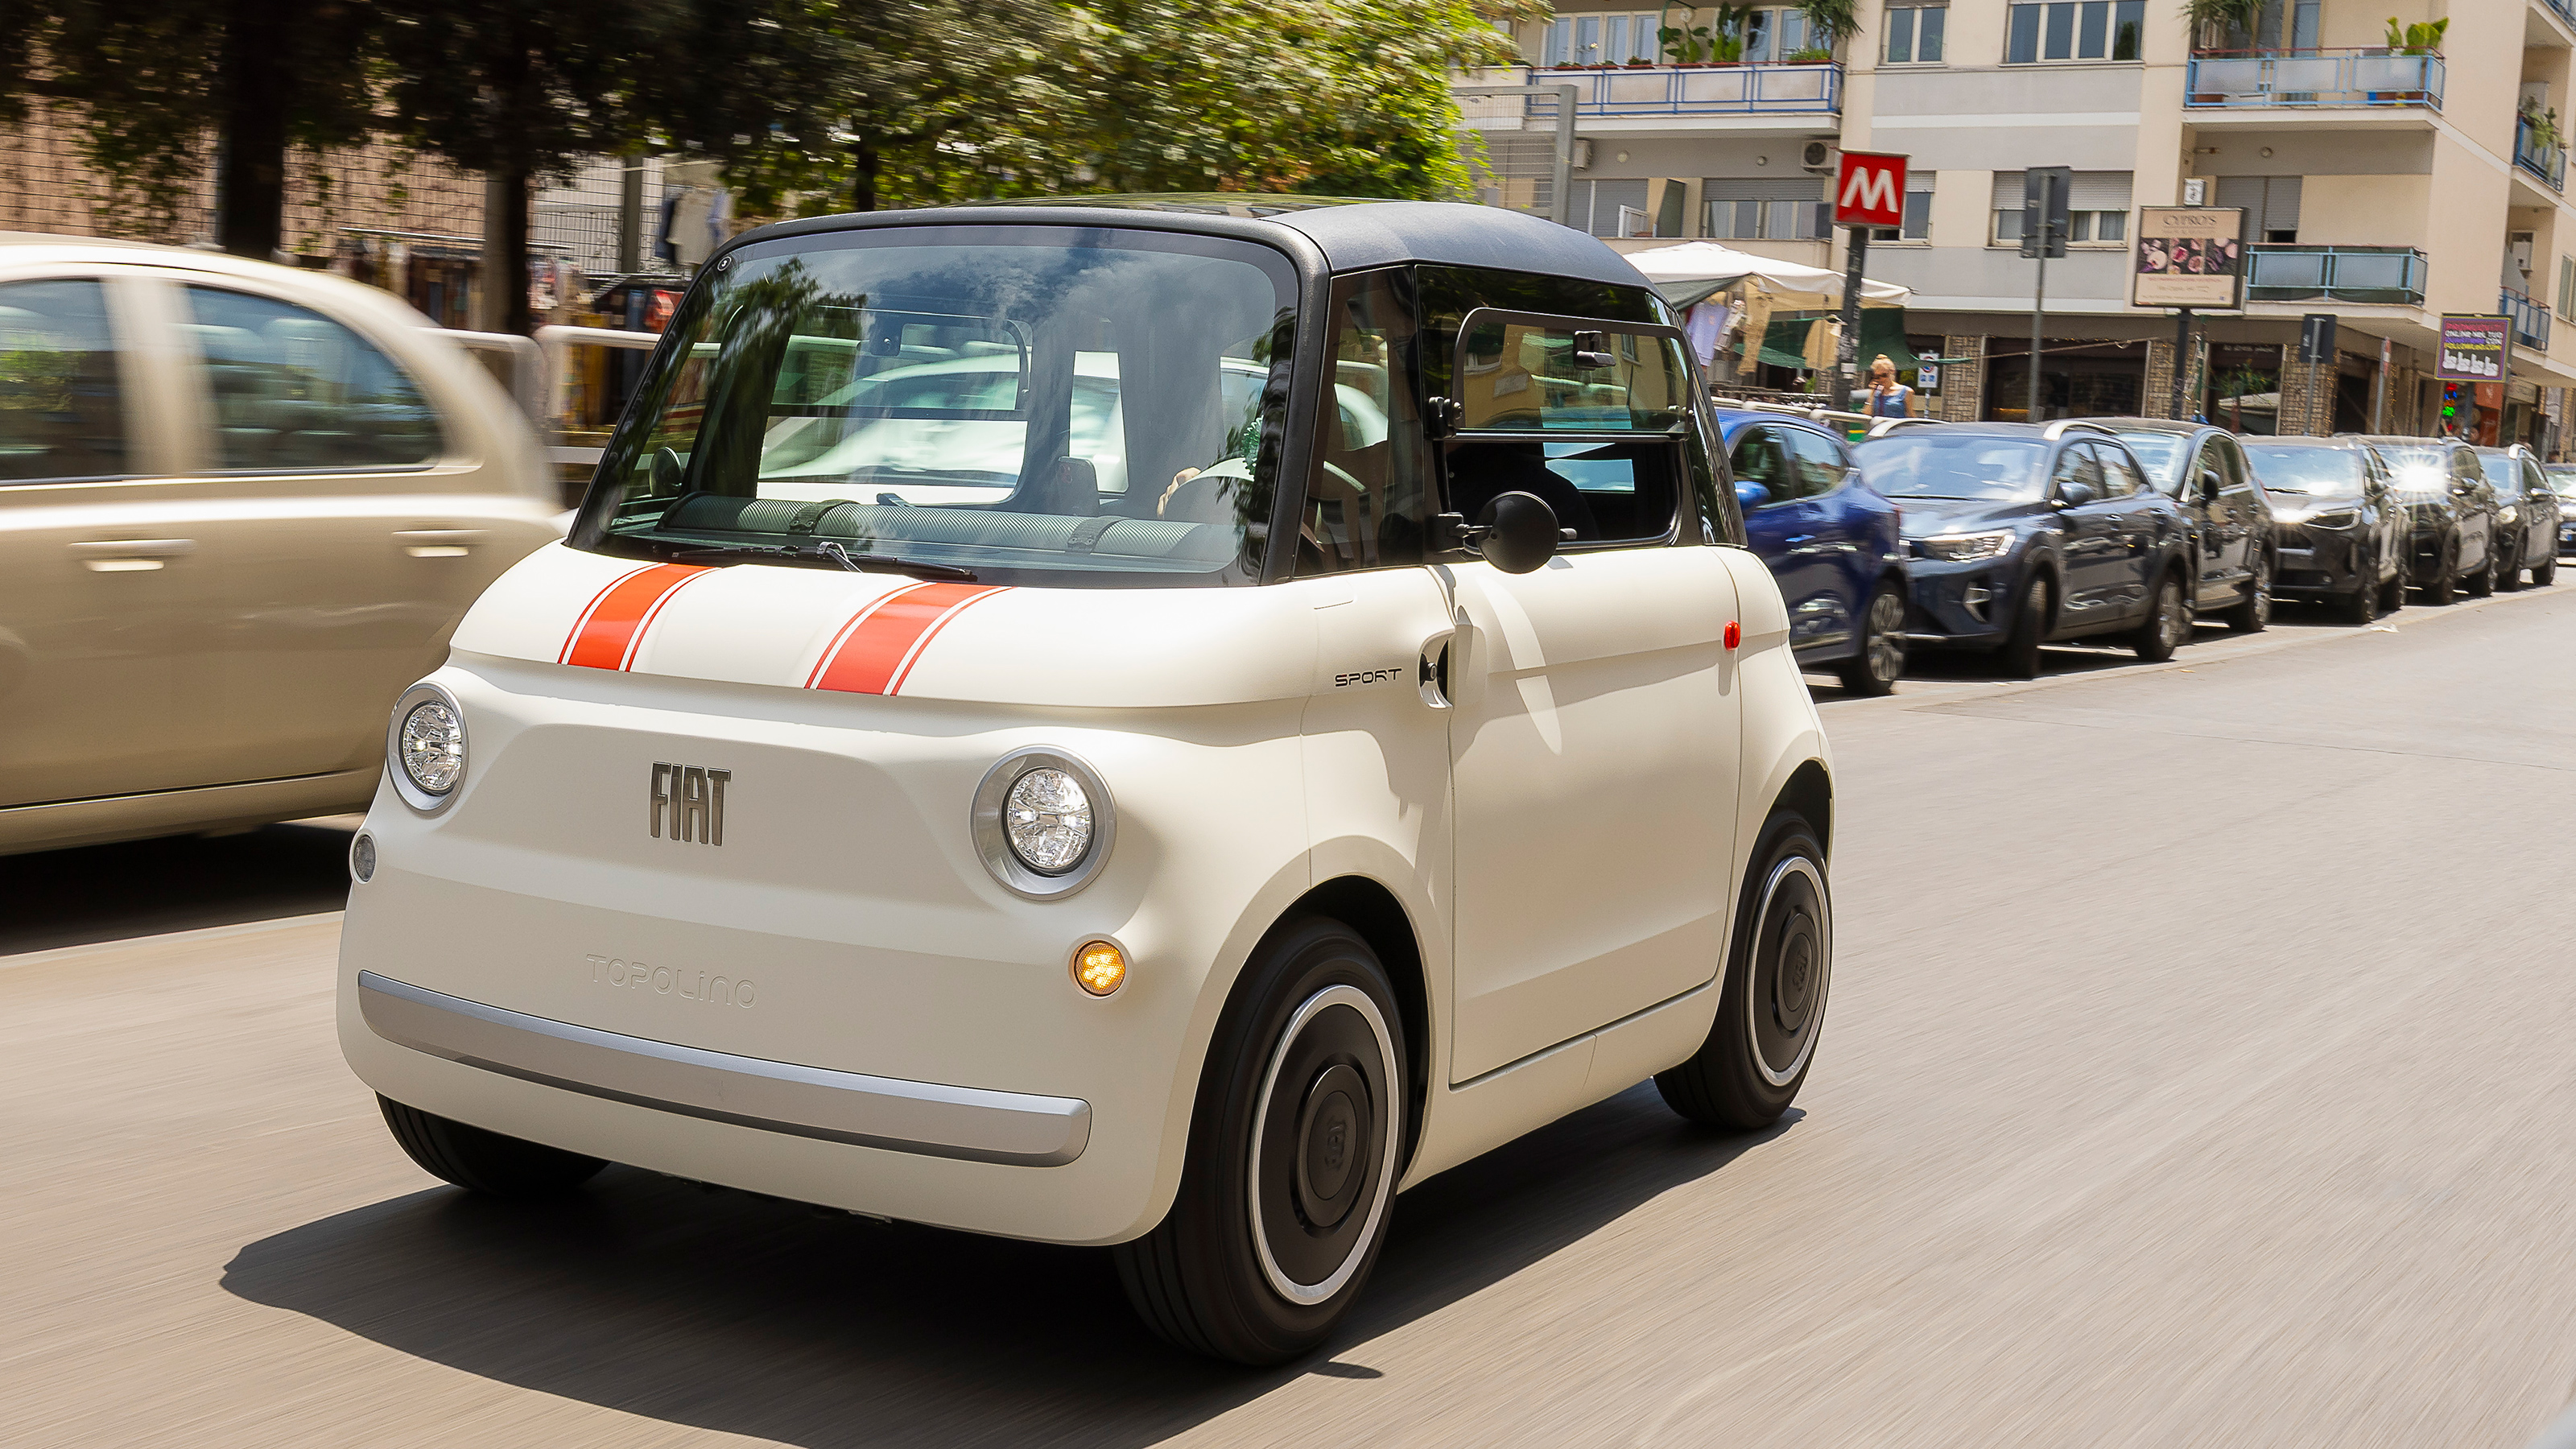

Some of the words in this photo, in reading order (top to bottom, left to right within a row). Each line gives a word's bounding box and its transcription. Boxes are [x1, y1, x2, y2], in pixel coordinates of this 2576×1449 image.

[1839, 166, 1899, 213] M
[1335, 667, 1402, 687] SPORT
[650, 761, 732, 847] FIAT
